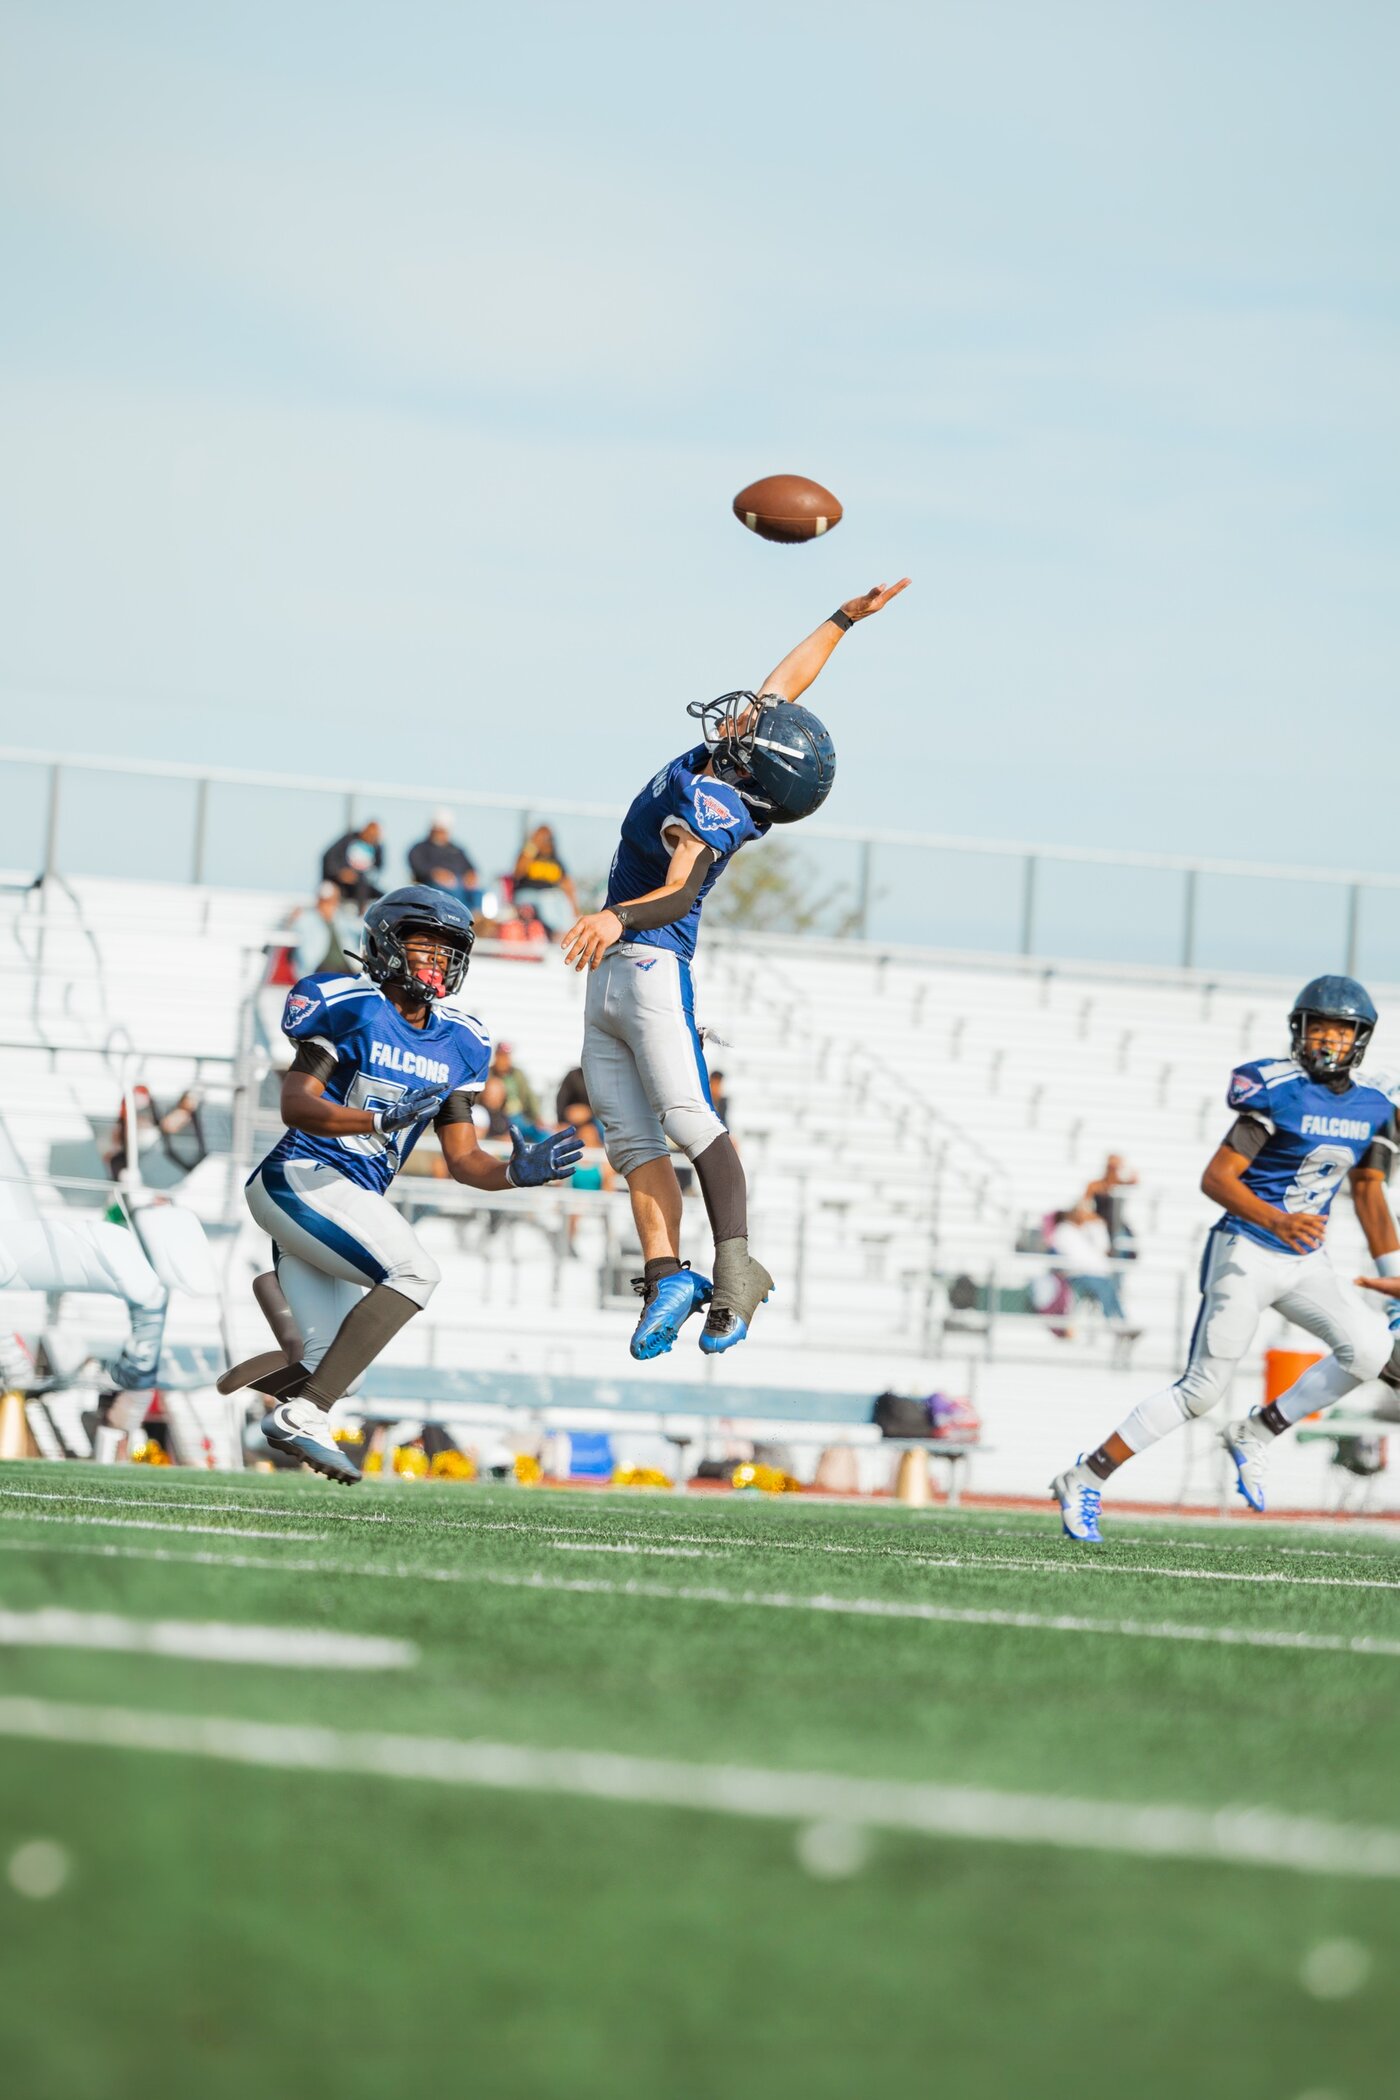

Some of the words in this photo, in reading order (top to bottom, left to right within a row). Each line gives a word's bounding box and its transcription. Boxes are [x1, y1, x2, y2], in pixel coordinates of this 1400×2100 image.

[369, 1040, 450, 1084] FALCONS
[1301, 1115, 1370, 1140] FALCONS
[1283, 1144, 1356, 1214] 8
